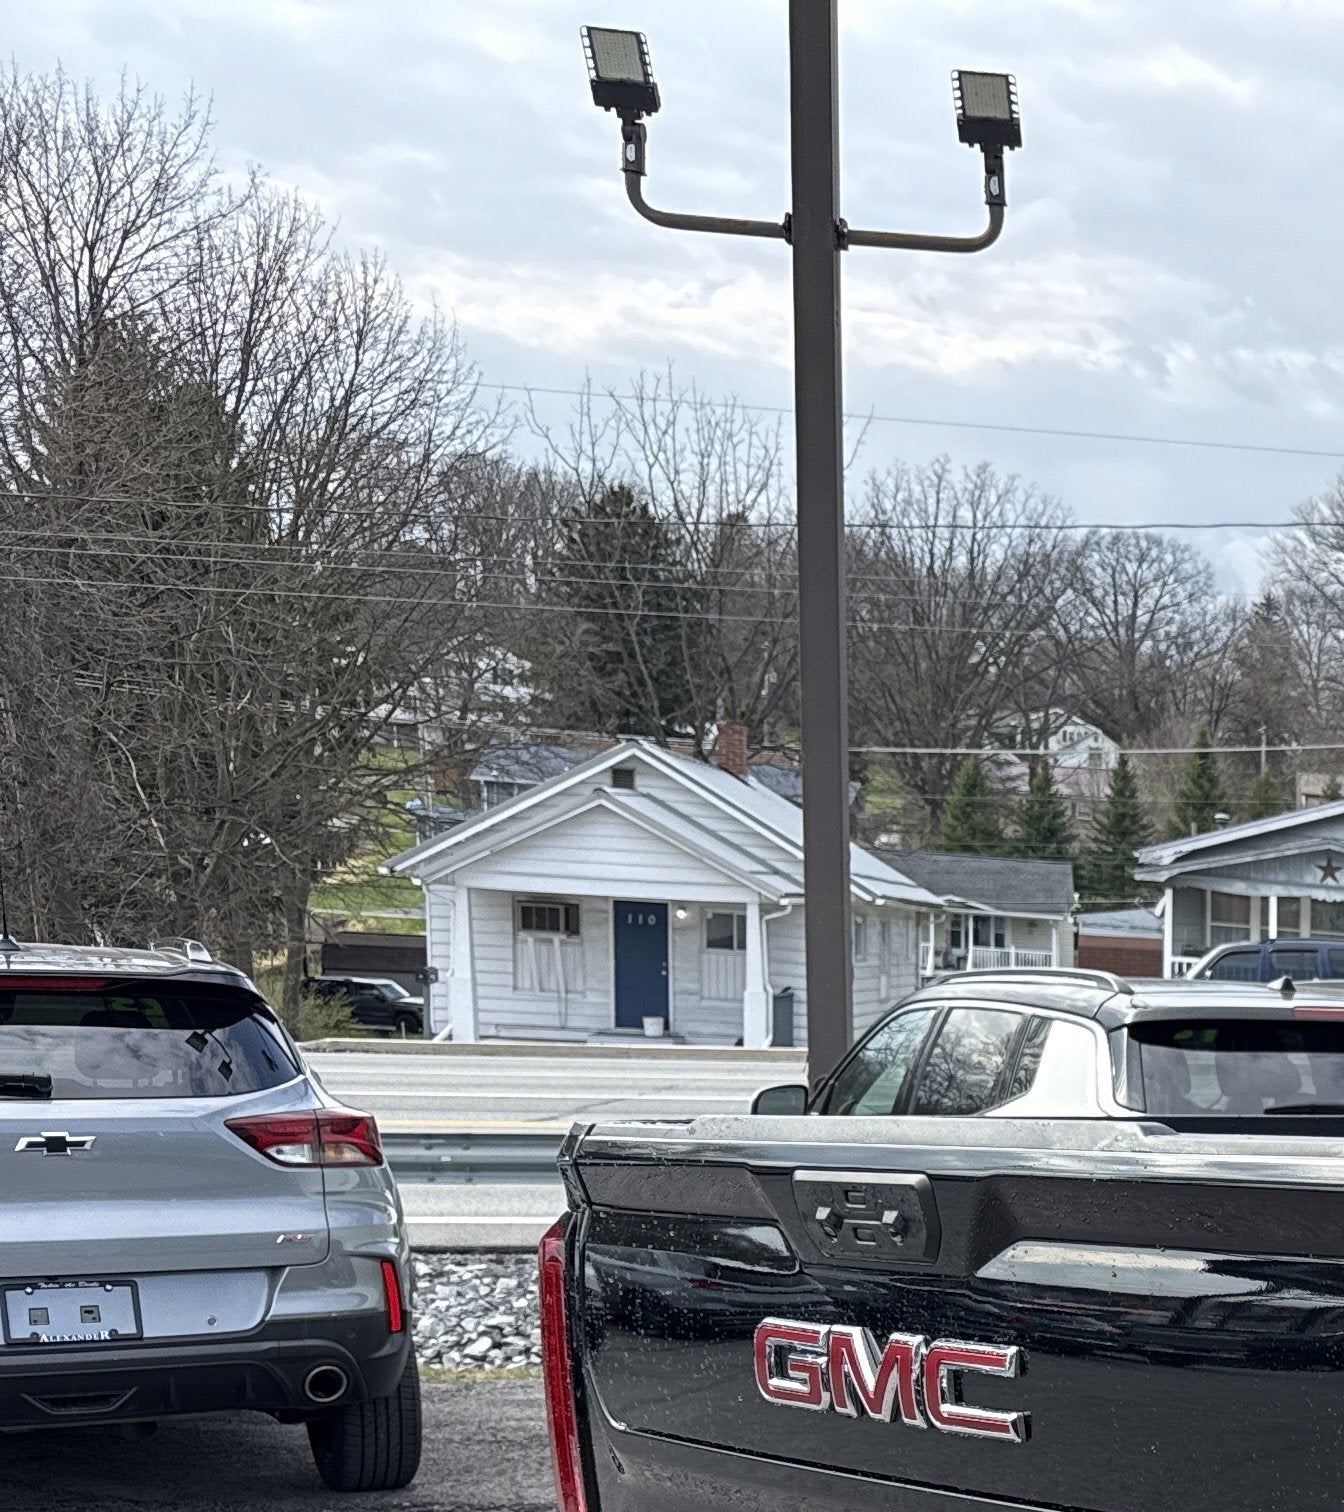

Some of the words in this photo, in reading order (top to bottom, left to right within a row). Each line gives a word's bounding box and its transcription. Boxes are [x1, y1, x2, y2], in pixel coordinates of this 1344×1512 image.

[627, 913, 657, 926] 110
[40, 1330, 111, 1343] ALEXANDER
[753, 1317, 1029, 1443] GMC
